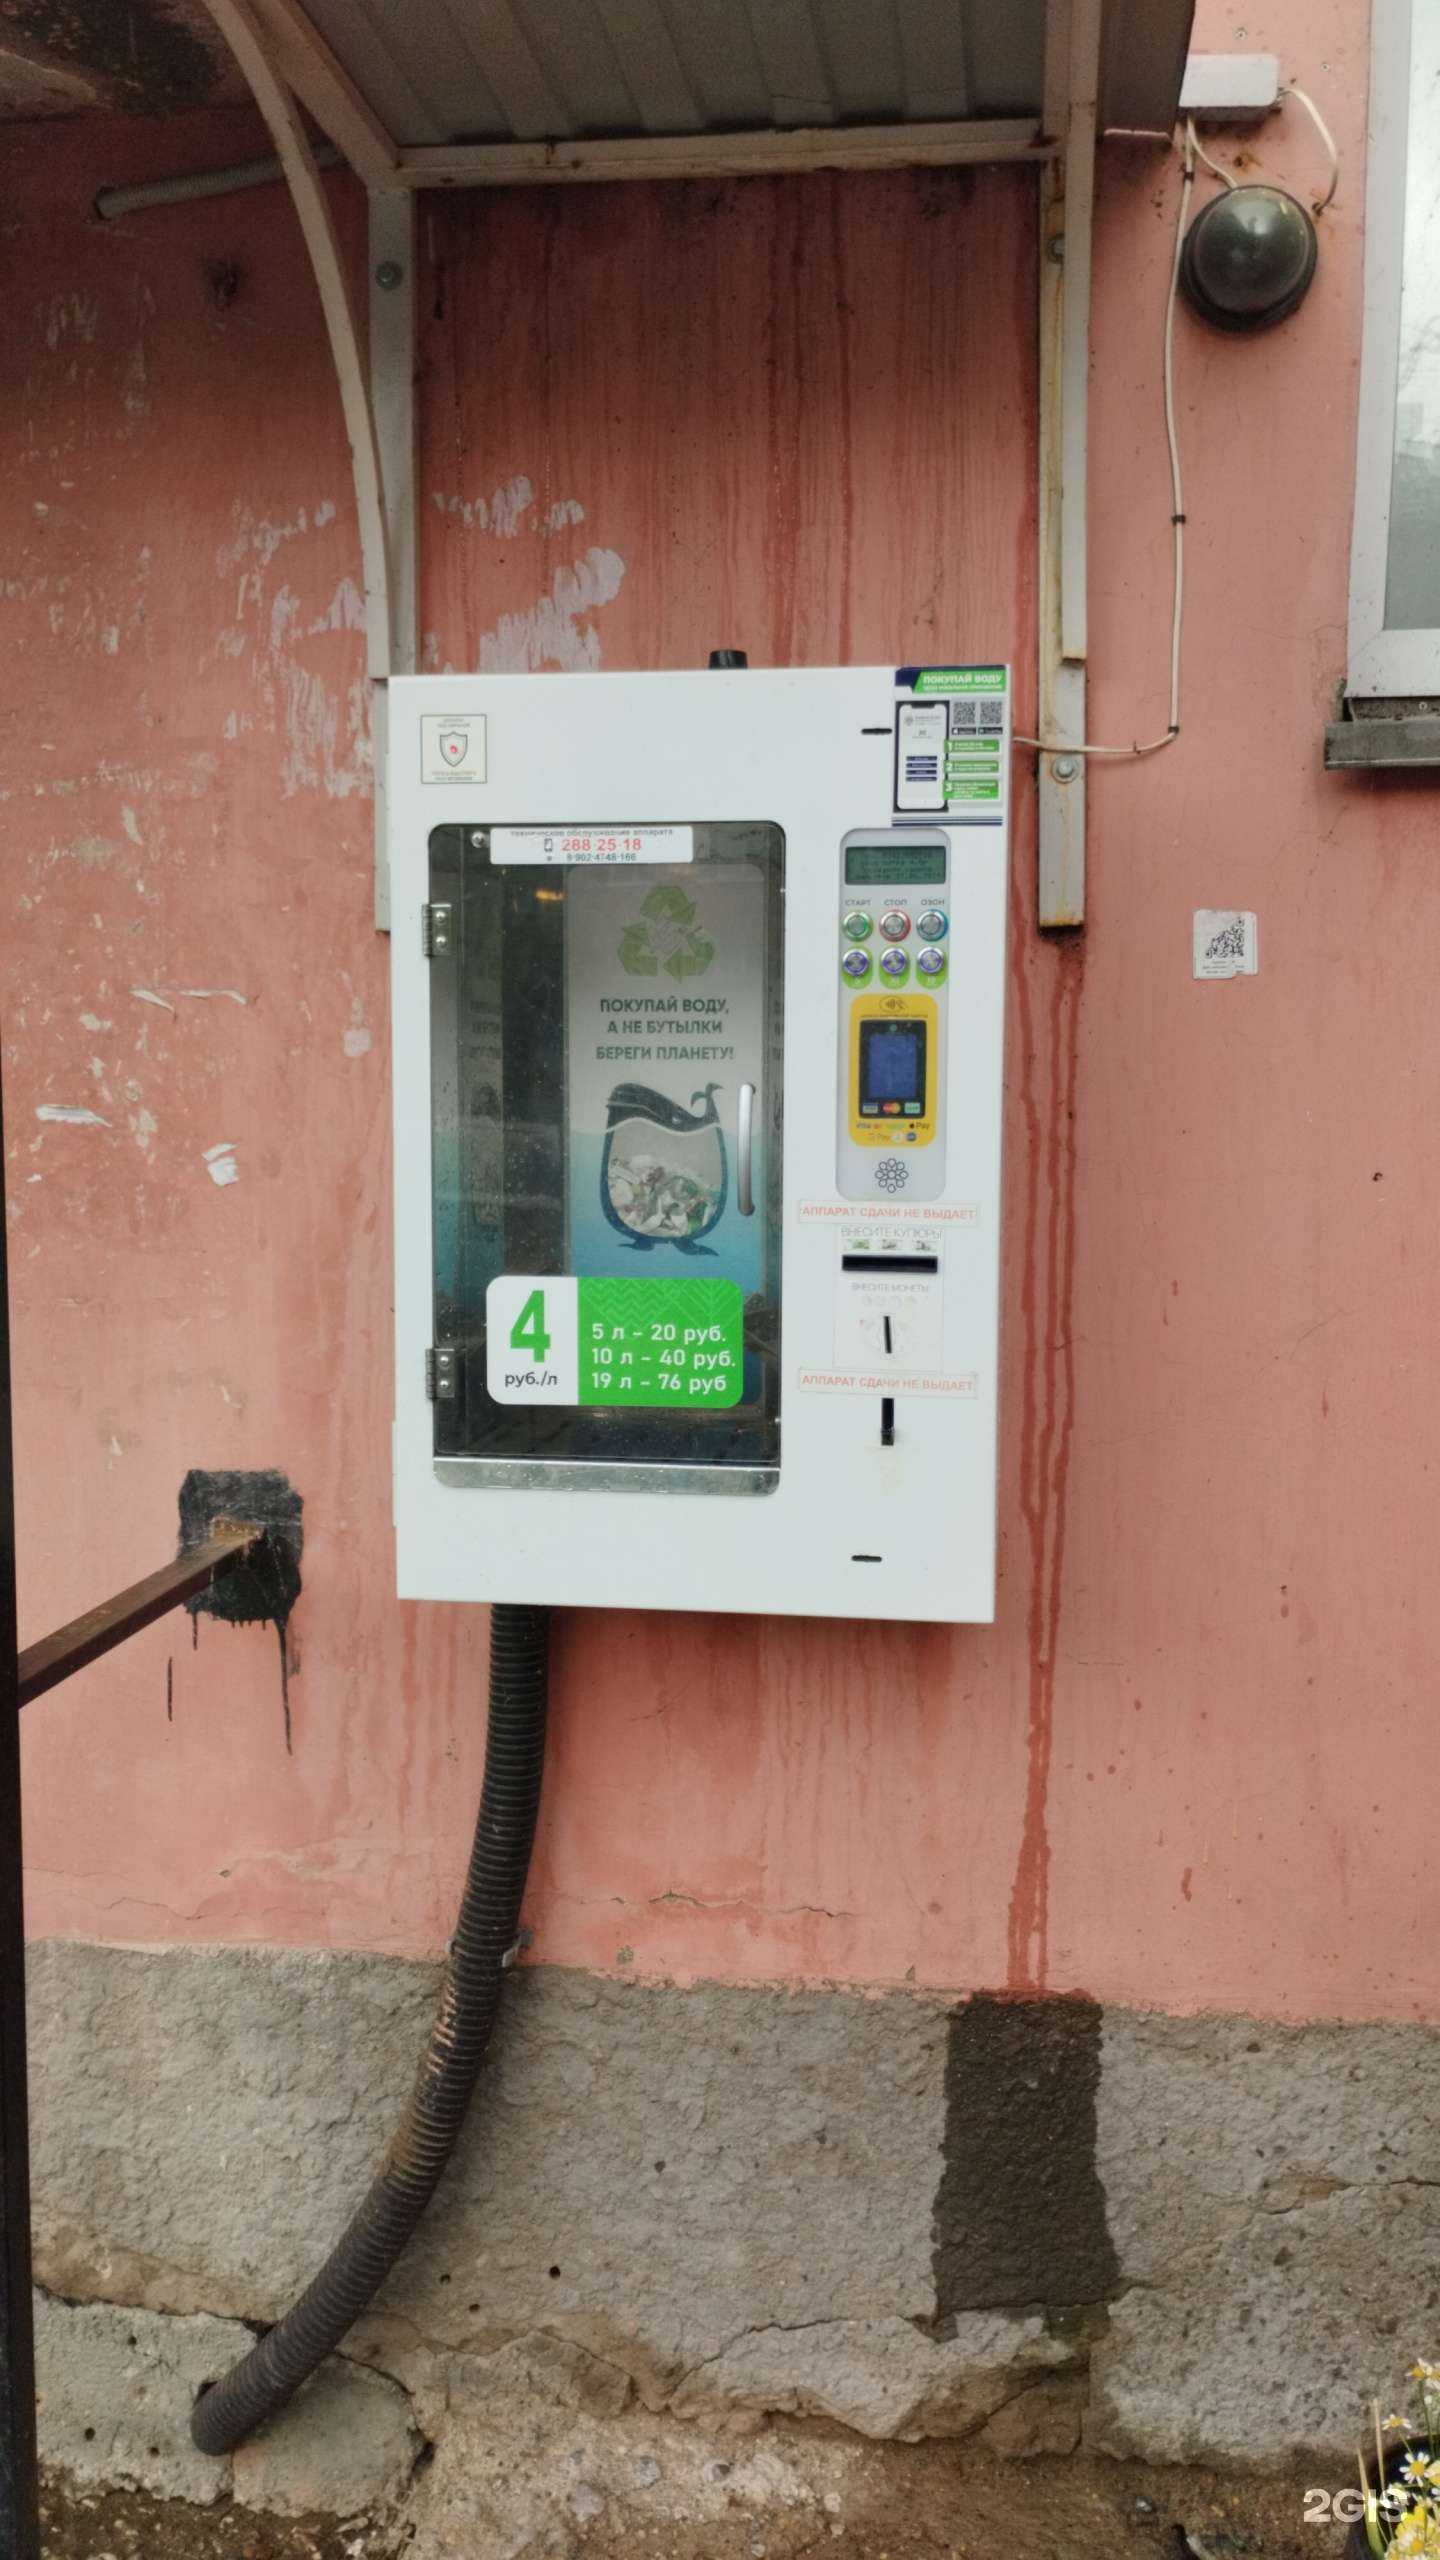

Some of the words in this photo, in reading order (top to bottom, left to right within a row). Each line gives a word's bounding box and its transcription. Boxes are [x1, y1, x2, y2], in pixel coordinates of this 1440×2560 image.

[922, 673, 972, 685] ПОКУПАЙ
[600, 995, 678, 1013] ПОКУПАЙ
[682, 998, 730, 1014] ВОДУ,
[607, 1020, 618, 1034] А
[622, 1020, 642, 1034] НЕ
[646, 1020, 722, 1034] БУТЫЛКИ
[596, 1046, 652, 1060] БЕРЕГИ
[656, 1046, 734, 1060] ПЛАНЕТУ!
[802, 1207, 856, 1217] АППАРАТ
[860, 1208, 900, 1219] СДАЧИ
[904, 1209, 920, 1218] НЕ
[923, 1209, 975, 1220] ВЫДАЕТ
[510, 1290, 551, 1363] 4
[592, 1323, 604, 1340] 5
[611, 1327, 624, 1340] л
[651, 1324, 676, 1341] 20
[684, 1325, 726, 1345] руб.
[592, 1348, 612, 1365] 10
[620, 1352, 633, 1365] л
[659, 1349, 686, 1366] 40
[693, 1350, 736, 1370] руб.
[504, 1370, 558, 1388] руб./л
[592, 1373, 612, 1389] 19
[619, 1376, 632, 1389] л
[658, 1374, 681, 1390] 76
[802, 1375, 855, 1387] АППАРАТ
[859, 1377, 900, 1389] СДАЧИ
[904, 1379, 919, 1389] НЕ
[923, 1379, 974, 1391] ВЫДАЕТ
